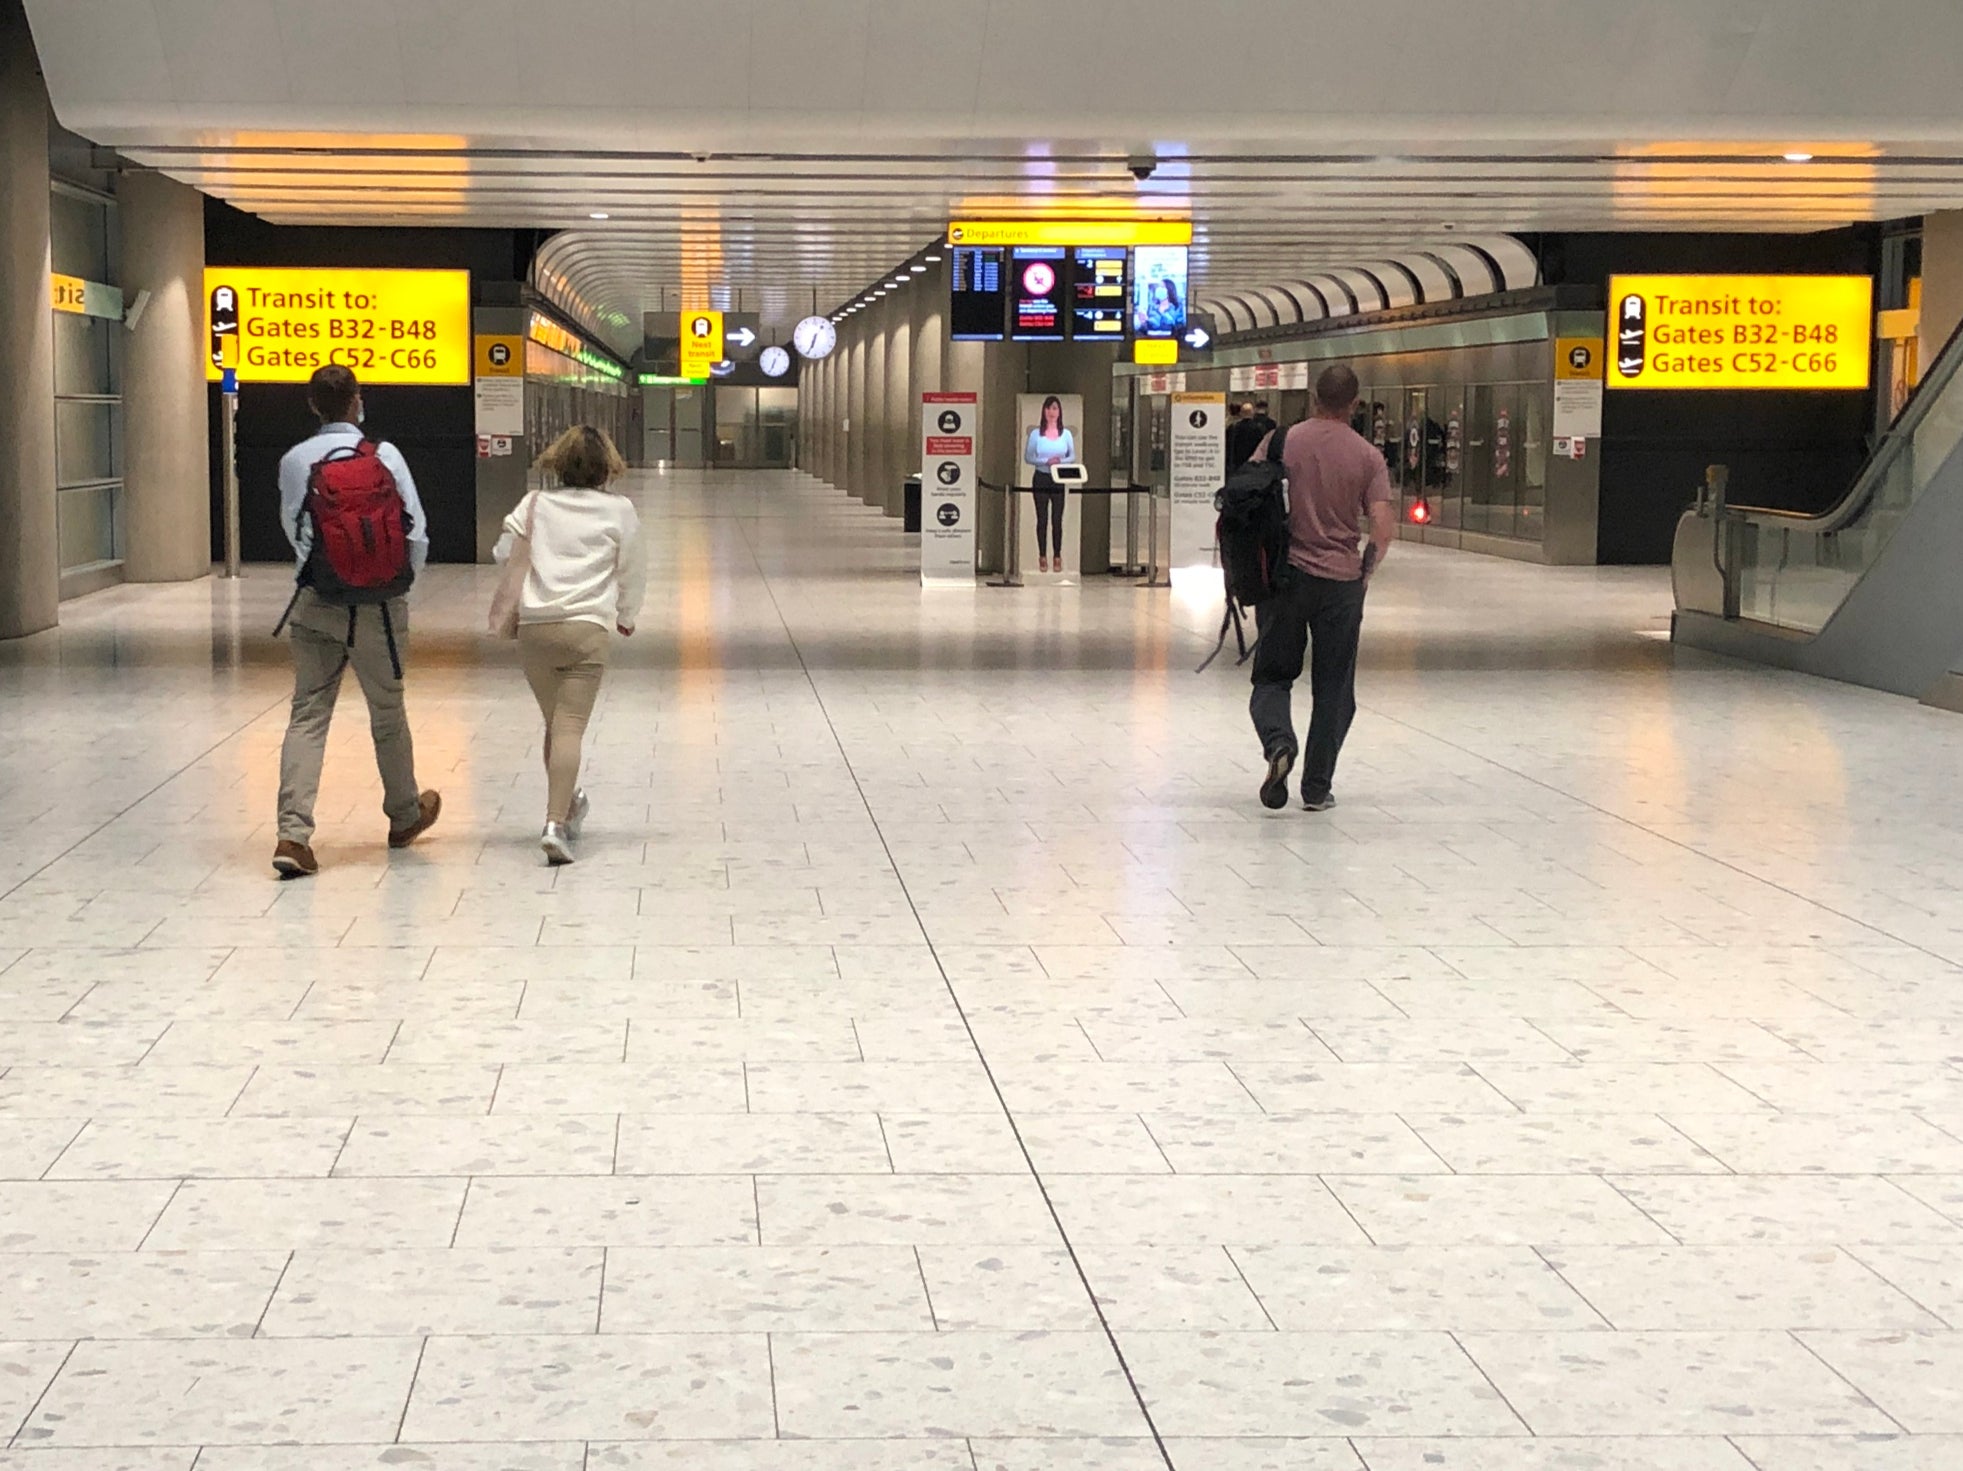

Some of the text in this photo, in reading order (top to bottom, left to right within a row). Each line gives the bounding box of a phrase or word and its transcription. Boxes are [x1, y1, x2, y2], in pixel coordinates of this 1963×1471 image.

[966, 228, 1029, 241] Departures
[246, 287, 377, 311] Transit to:
[1654, 294, 1782, 316] Transit to:
[247, 317, 437, 341] Gates B32-B48
[1653, 324, 1839, 345] Gates B32-B48
[247, 346, 321, 367] Gates
[1652, 353, 1838, 374] Gates C52-C66
